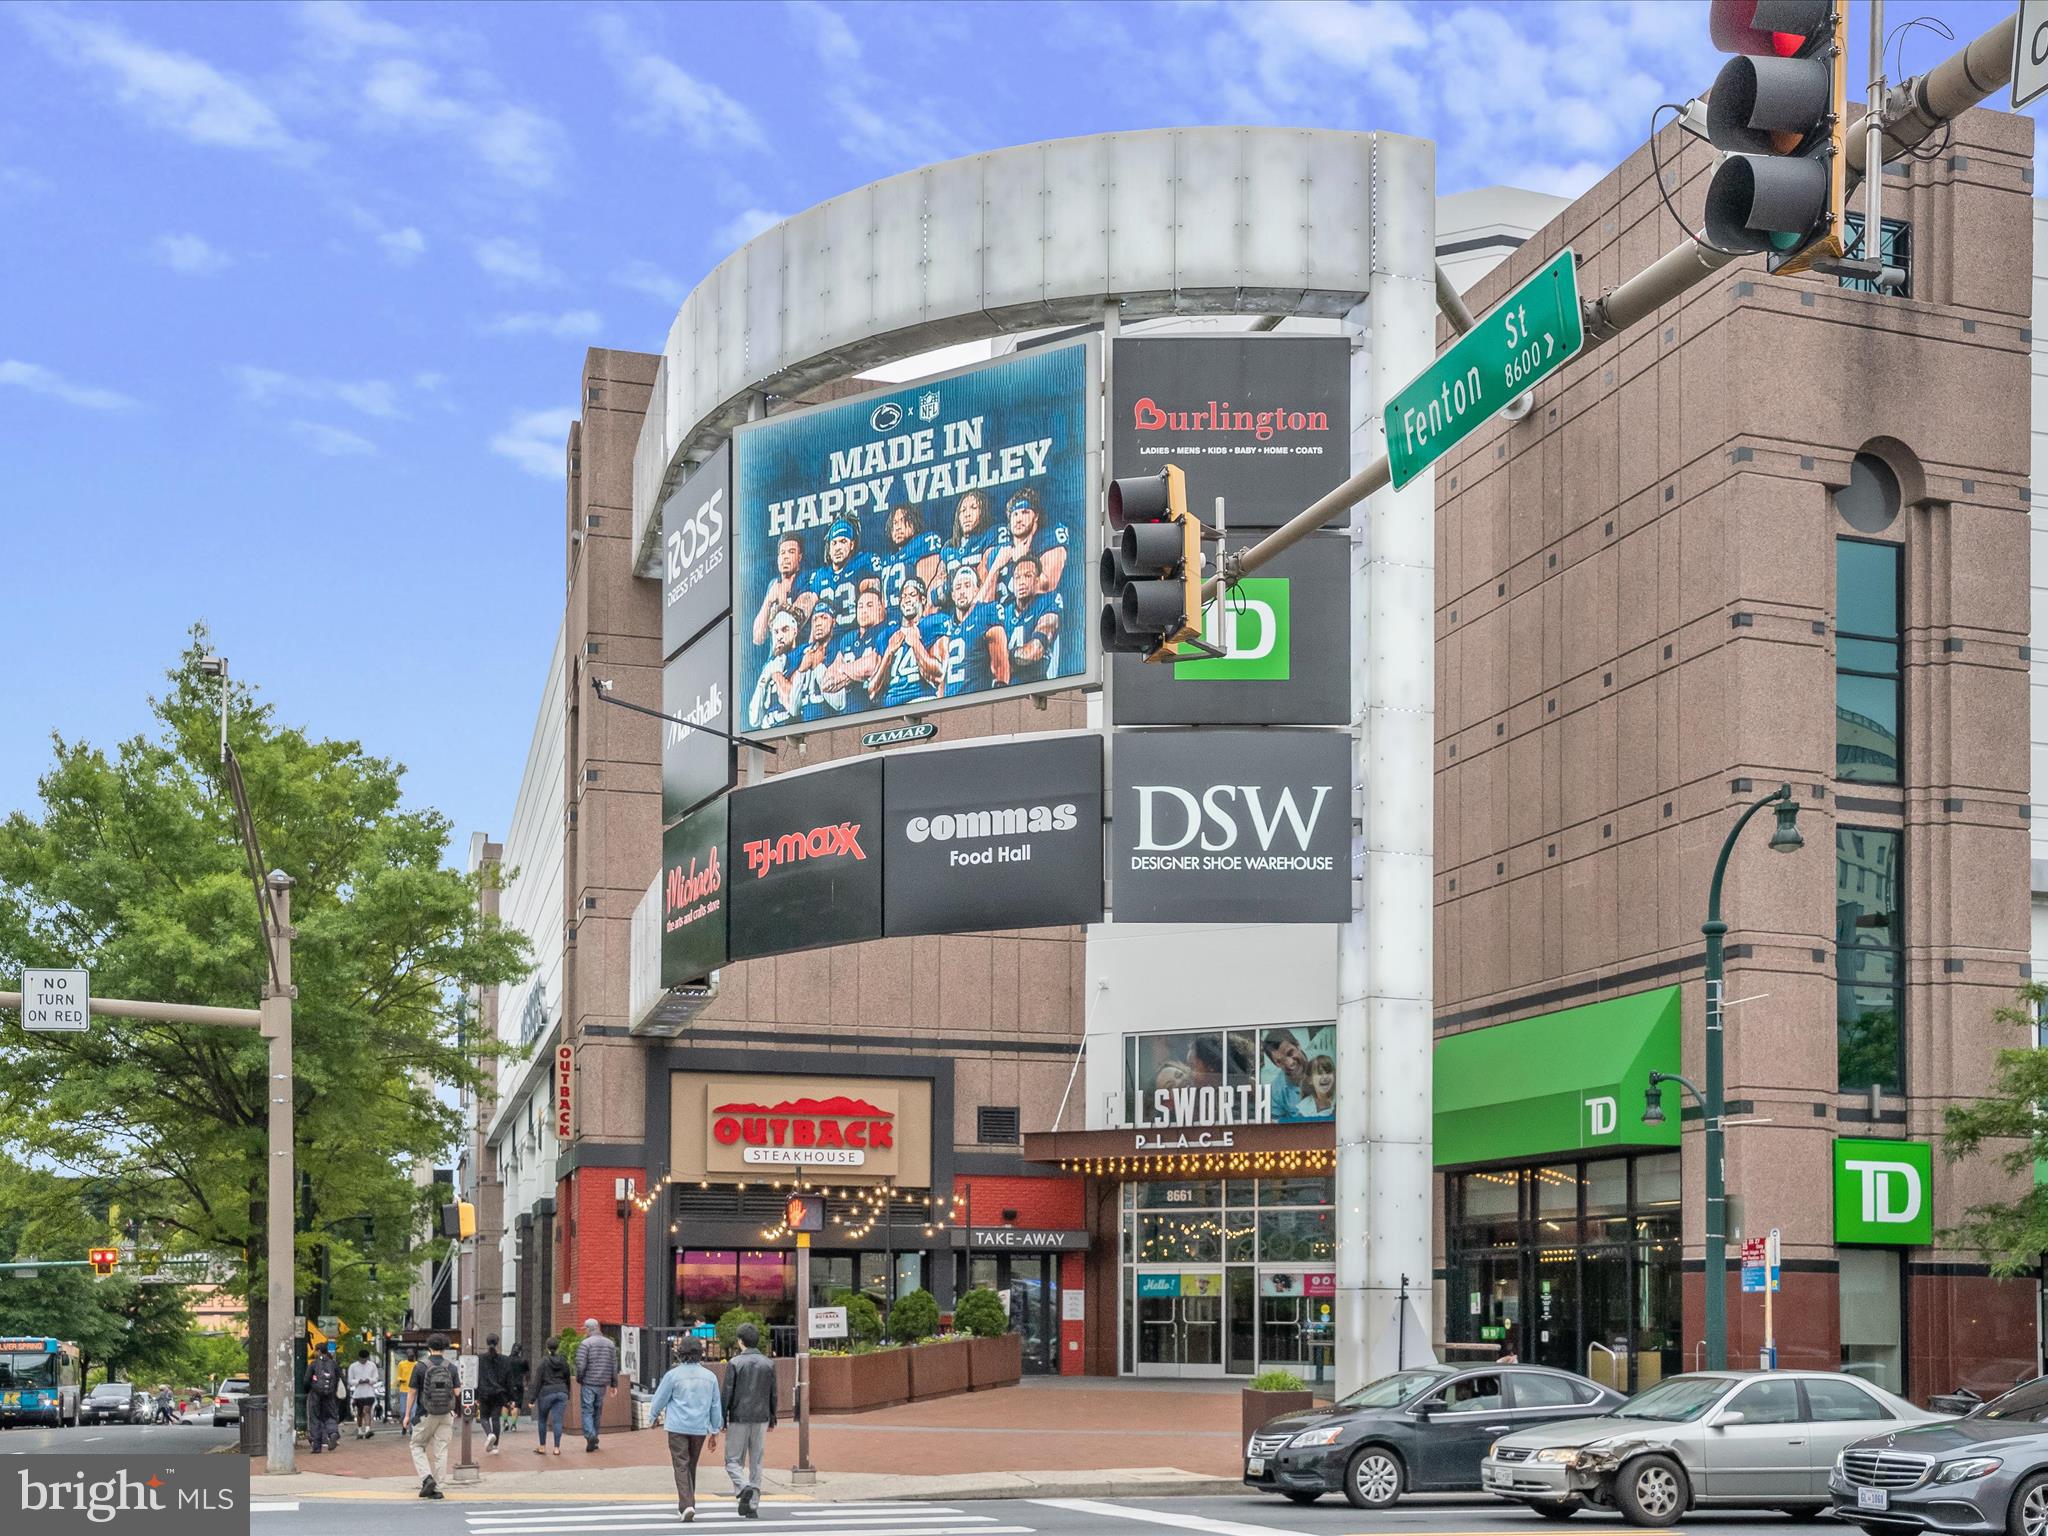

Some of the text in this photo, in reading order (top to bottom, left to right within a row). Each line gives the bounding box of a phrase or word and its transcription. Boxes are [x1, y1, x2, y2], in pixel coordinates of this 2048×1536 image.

[1505, 303, 1528, 349] St
[1505, 341, 1541, 388] 8600
[1134, 397, 1330, 441] Burlington
[1404, 366, 1482, 455] Fenton
[829, 416, 984, 484] MADE IN
[1140, 446, 1323, 455] LADIES MENS KIDS BABY HOME COATS
[768, 438, 1053, 537] HAPPY VALLEY
[667, 487, 723, 585] ROSS
[705, 545, 723, 574] LESS
[666, 682, 722, 750] Marshalls
[867, 726, 926, 744] LAMAR
[905, 803, 1078, 843] commas
[1131, 784, 1333, 852] DSW
[950, 844, 1031, 867] Food Hall
[1131, 856, 1333, 871] DESIGNER SHOE WAREHOUSE
[666, 846, 720, 914] Michaels
[37, 994, 74, 1005] TURN
[44, 978, 67, 989] NO
[28, 1010, 82, 1022] ON RED
[559, 1047, 572, 1137] OUTBACK
[1103, 1084, 1272, 1129] ELLSWORTH
[713, 1116, 894, 1149] OUTBACK
[1585, 1096, 1617, 1136] TD
[753, 1150, 856, 1163] STEAKHOUSE
[1135, 1131, 1234, 1150] PLACE
[1167, 1189, 1192, 1202] 8661
[1845, 1159, 1922, 1223] TD
[976, 1232, 1065, 1246] TAKE-AWAY
[1143, 1278, 1175, 1291] Hello!
